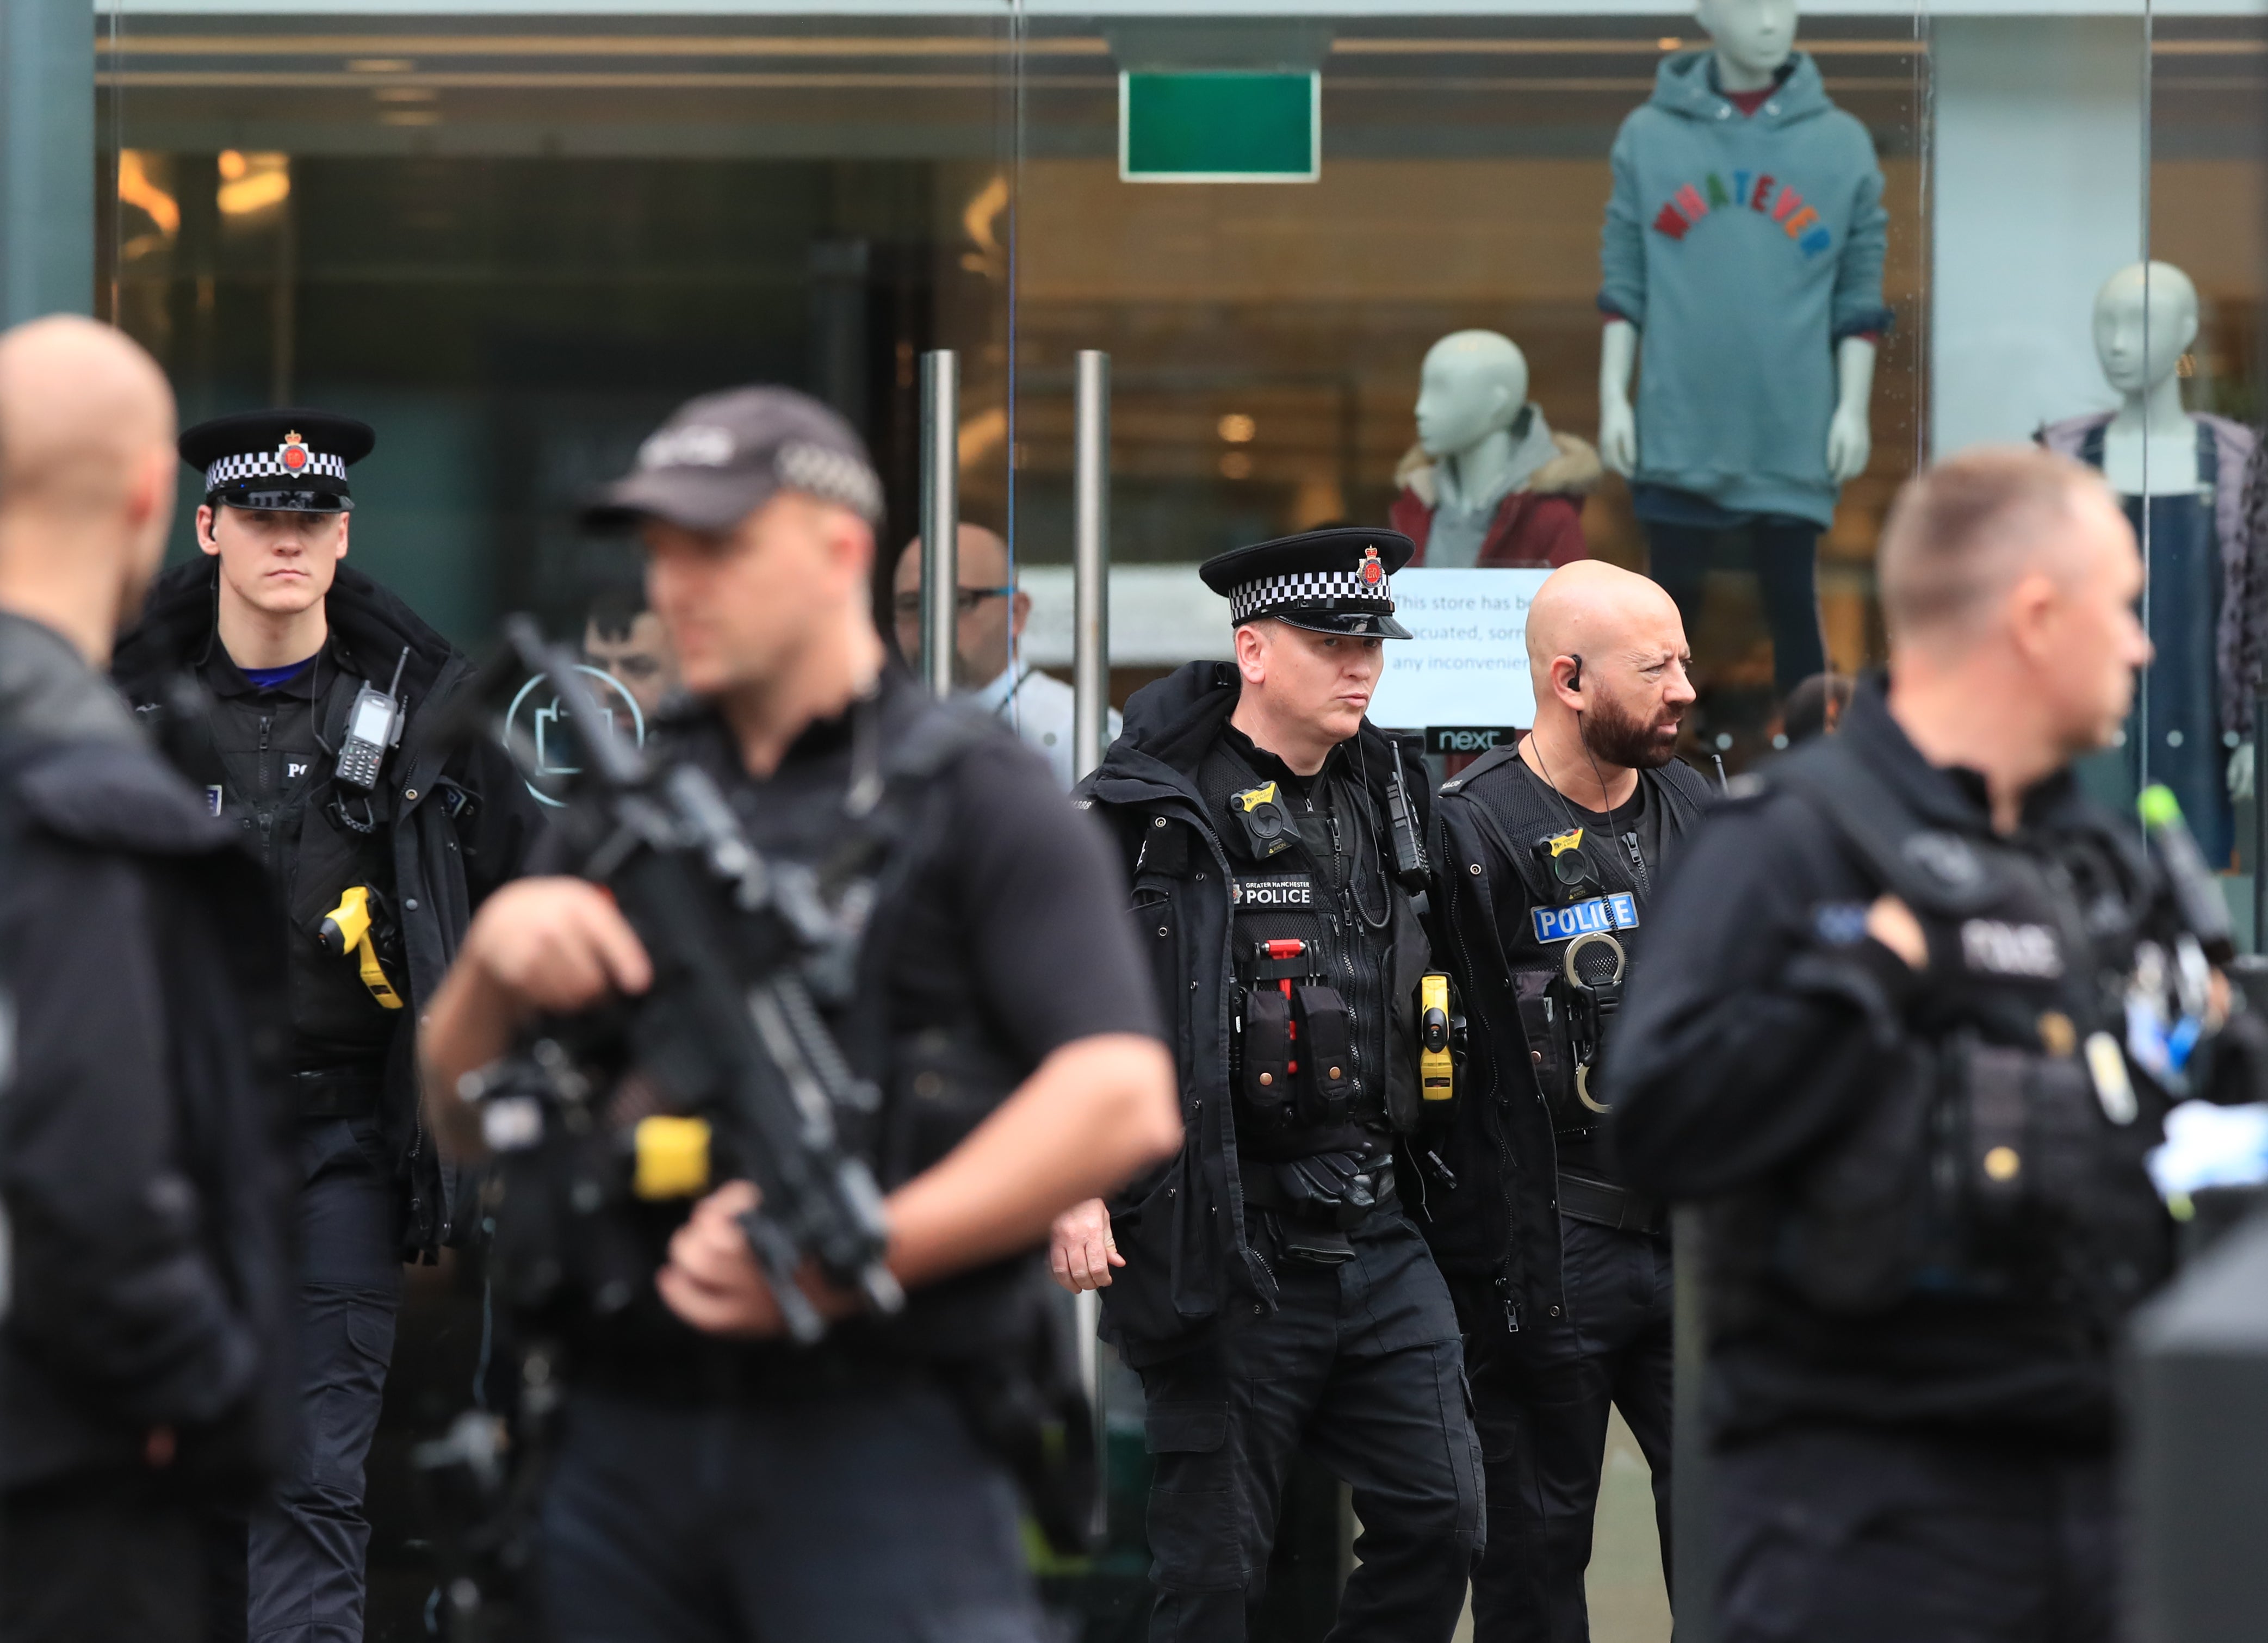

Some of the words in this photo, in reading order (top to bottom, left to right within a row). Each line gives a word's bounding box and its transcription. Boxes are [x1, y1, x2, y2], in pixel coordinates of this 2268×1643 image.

[1393, 594, 1427, 610] This
[1432, 597, 1476, 610] store
[1481, 594, 1510, 610] has
[1406, 625, 1483, 642] acuated,
[1488, 628, 1525, 641] sorr
[1392, 657, 1423, 672] any
[1439, 730, 1501, 750] next
[1273, 842, 1286, 851] AXON
[1247, 889, 1310, 904] POLICE
[1540, 899, 1632, 937] POLICE
